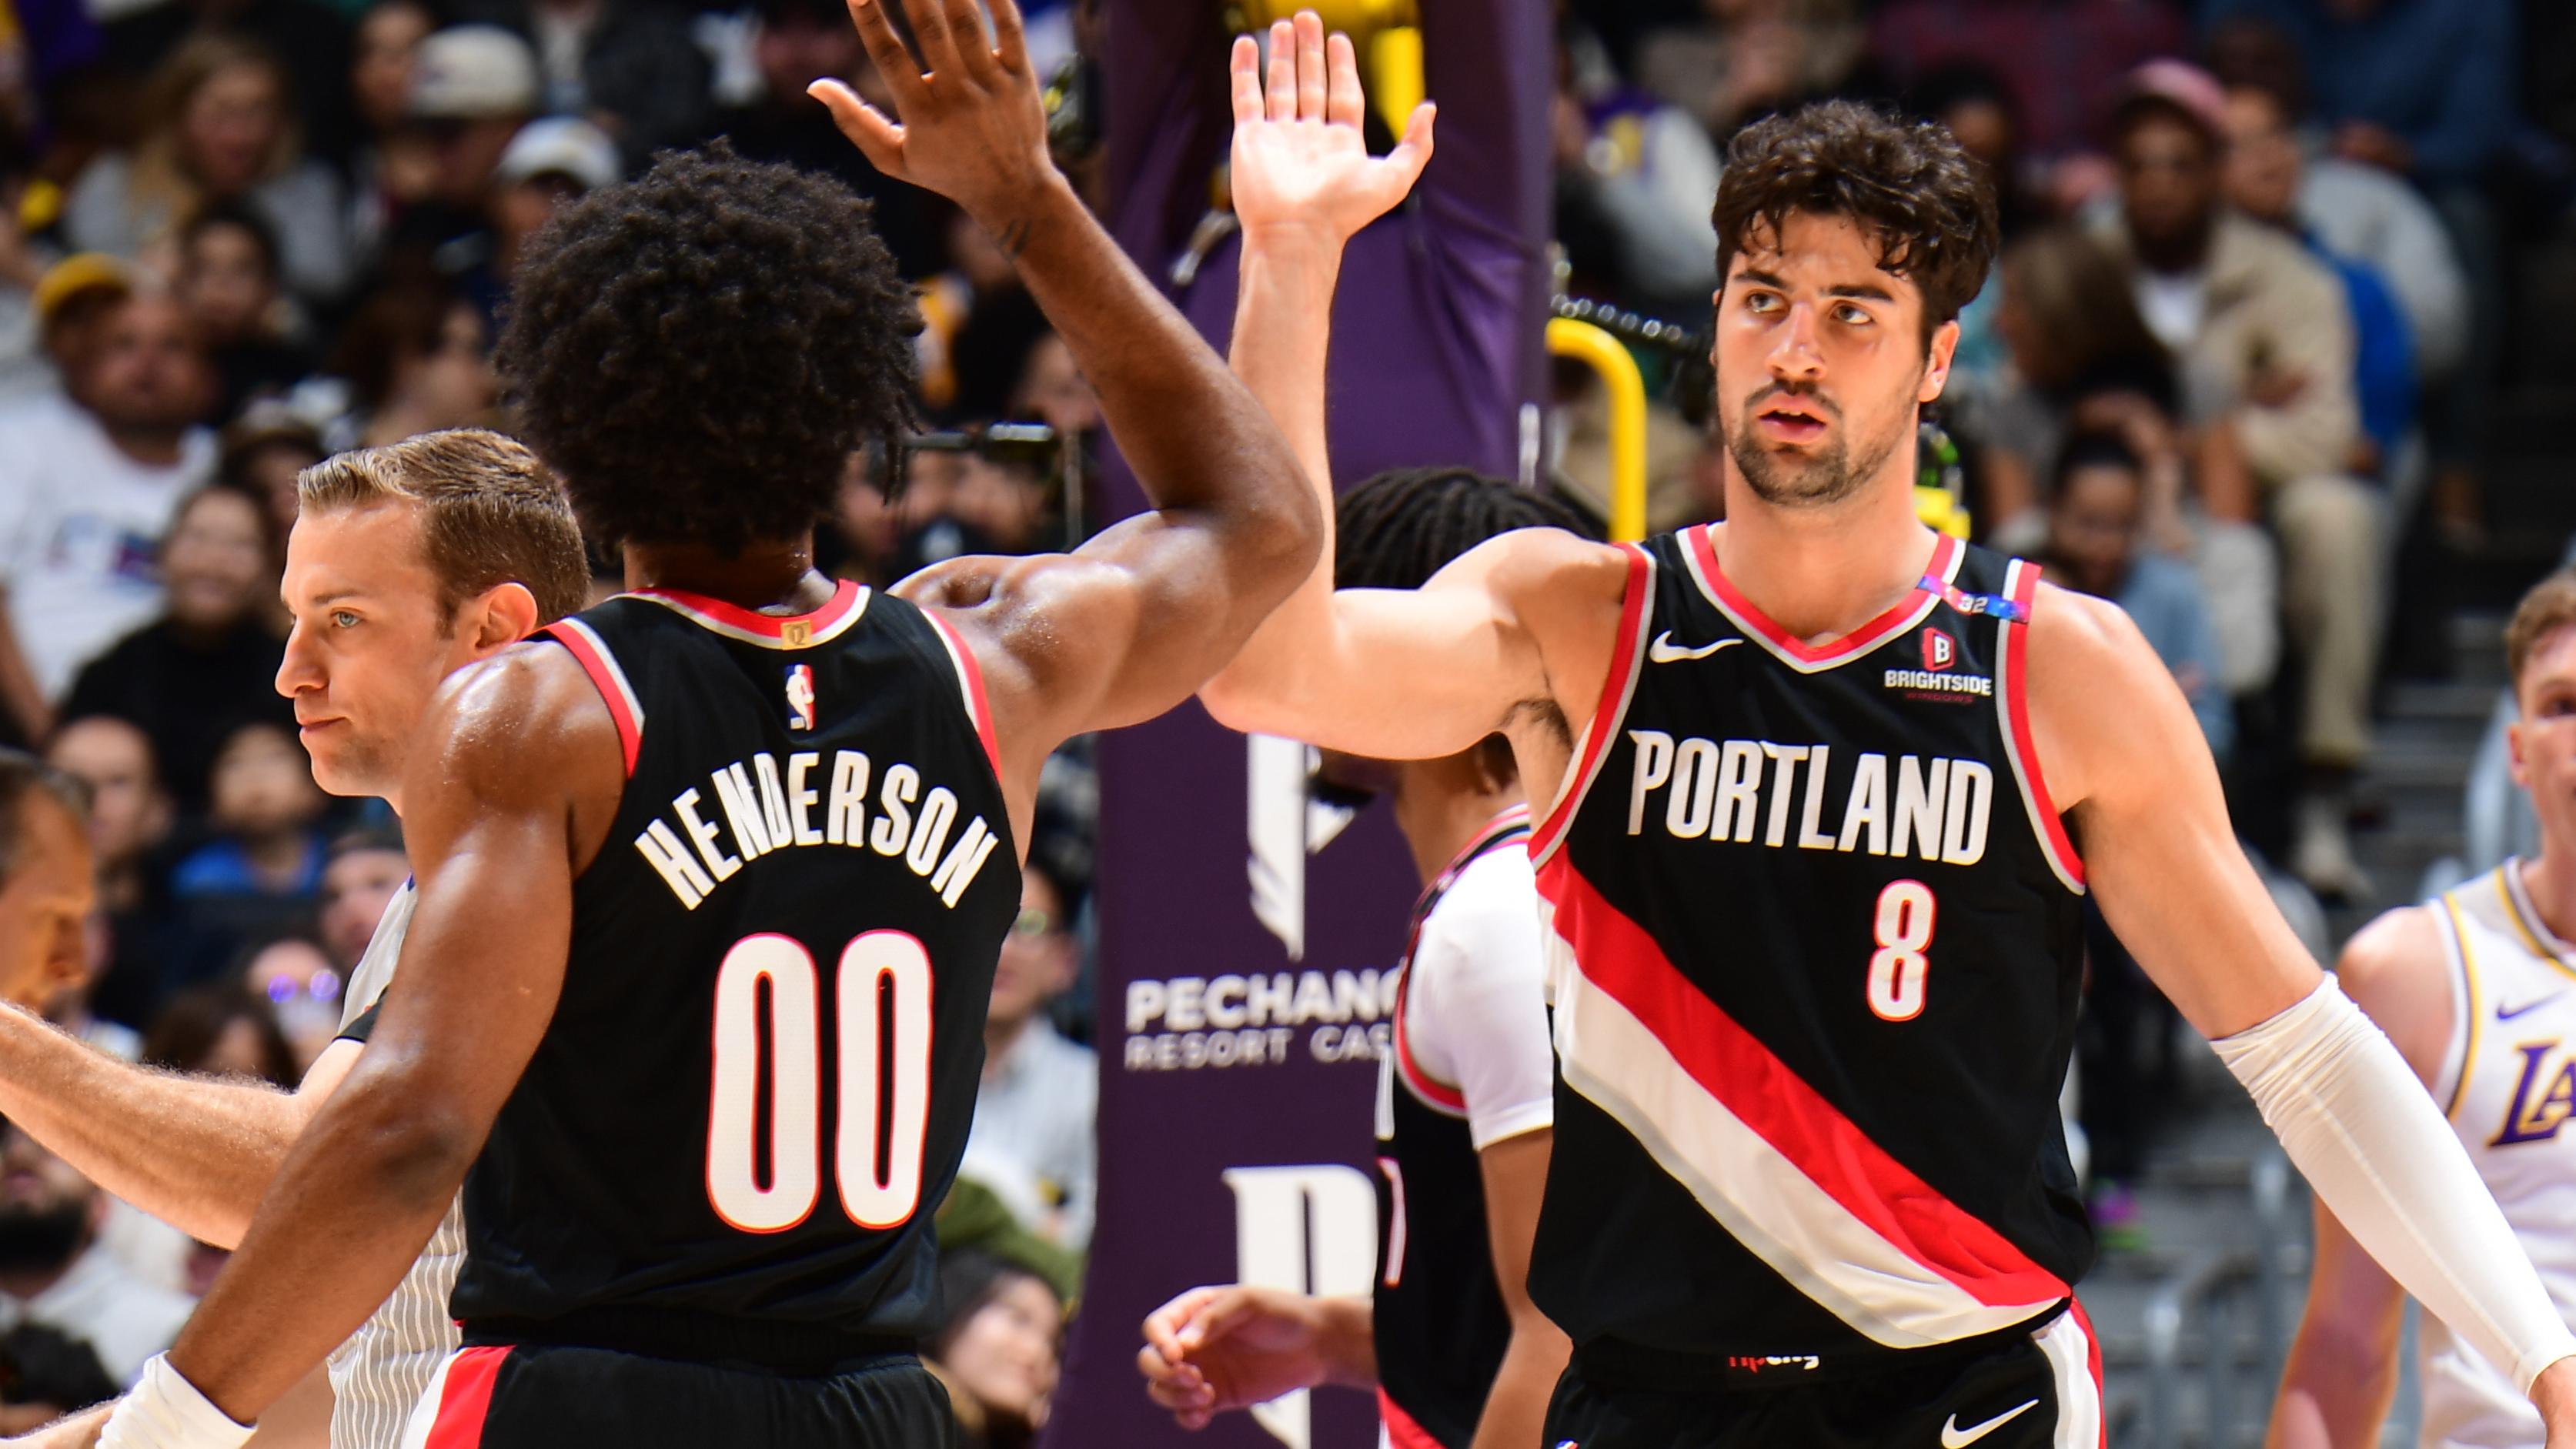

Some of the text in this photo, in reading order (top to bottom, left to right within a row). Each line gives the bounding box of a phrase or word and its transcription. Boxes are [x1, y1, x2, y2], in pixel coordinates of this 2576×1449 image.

[1934, 634, 1950, 663] B
[1958, 596, 1988, 613] 32
[1885, 669, 1992, 696] BRIGHTSIDE
[634, 750, 998, 910] HENDERSON
[1627, 730, 1993, 866] PORTLAND
[1867, 879, 1936, 1022] 8
[705, 928, 933, 1234] 00
[1124, 1027, 1293, 1070] RESORT
